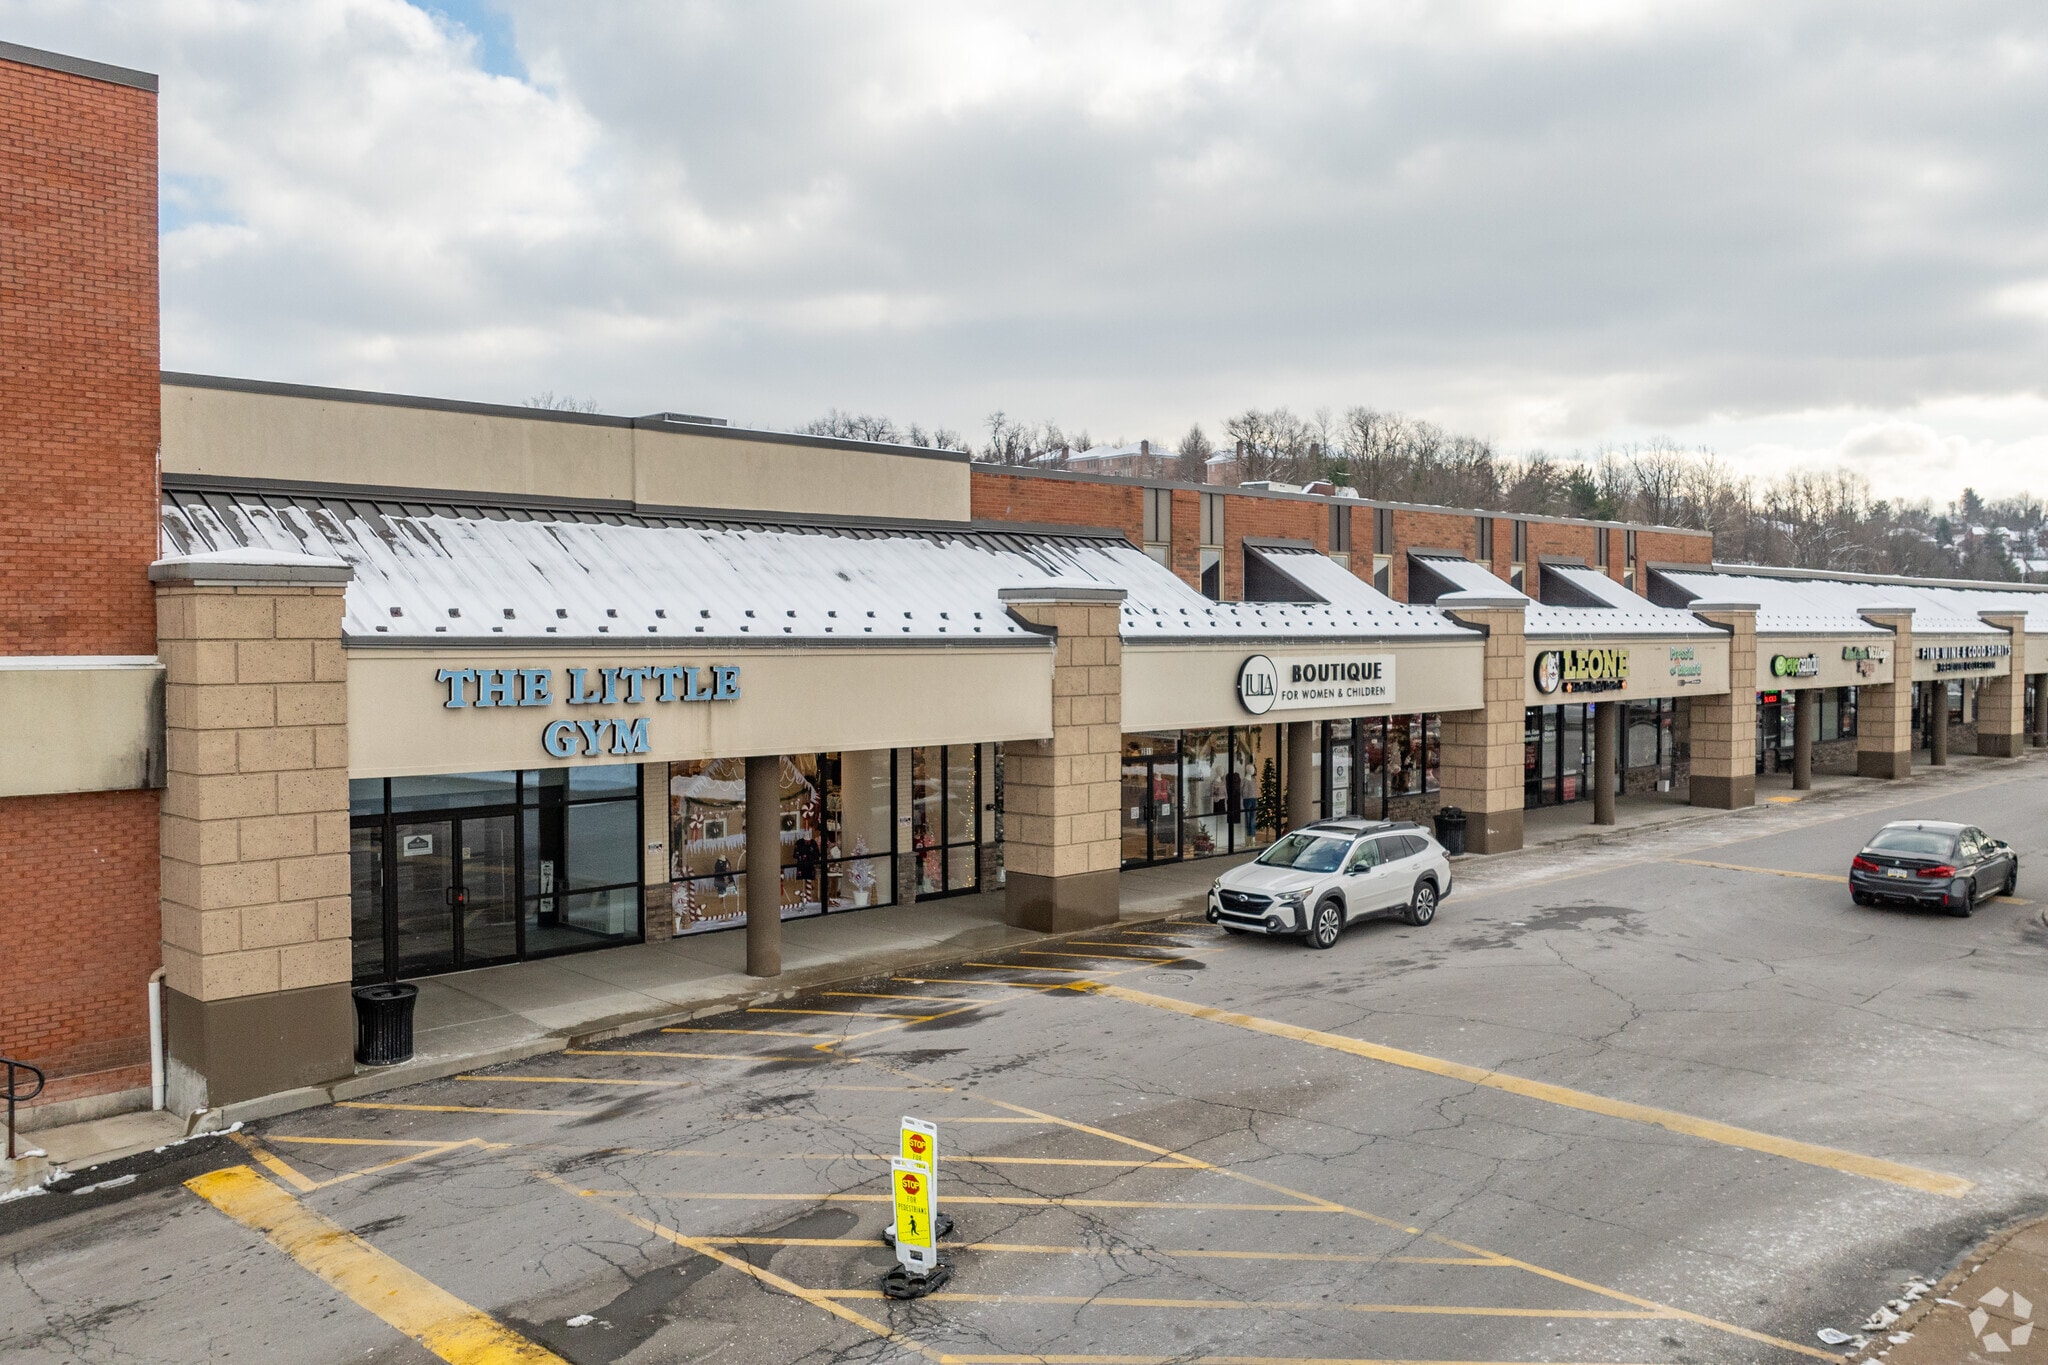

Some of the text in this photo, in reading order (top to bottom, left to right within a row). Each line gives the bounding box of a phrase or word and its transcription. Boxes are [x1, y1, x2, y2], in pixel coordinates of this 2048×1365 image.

[1920, 647, 1940, 660] FINE
[1941, 646, 1962, 659] WINE
[1967, 645, 1986, 657] GOOD
[1987, 644, 2011, 656] SPIRITS
[1563, 649, 1630, 679] LEONE
[1292, 662, 1382, 682] BOUTIQUE
[435, 666, 741, 708] THE LITTLE
[1281, 686, 1386, 700] FOR WOMEN & CHILDREN
[542, 717, 652, 757] GYM
[910, 1139, 926, 1149] STOP
[902, 1179, 920, 1190] STOP
[906, 1195, 917, 1203] FOR
[898, 1203, 927, 1215] PEDESTRIANS
